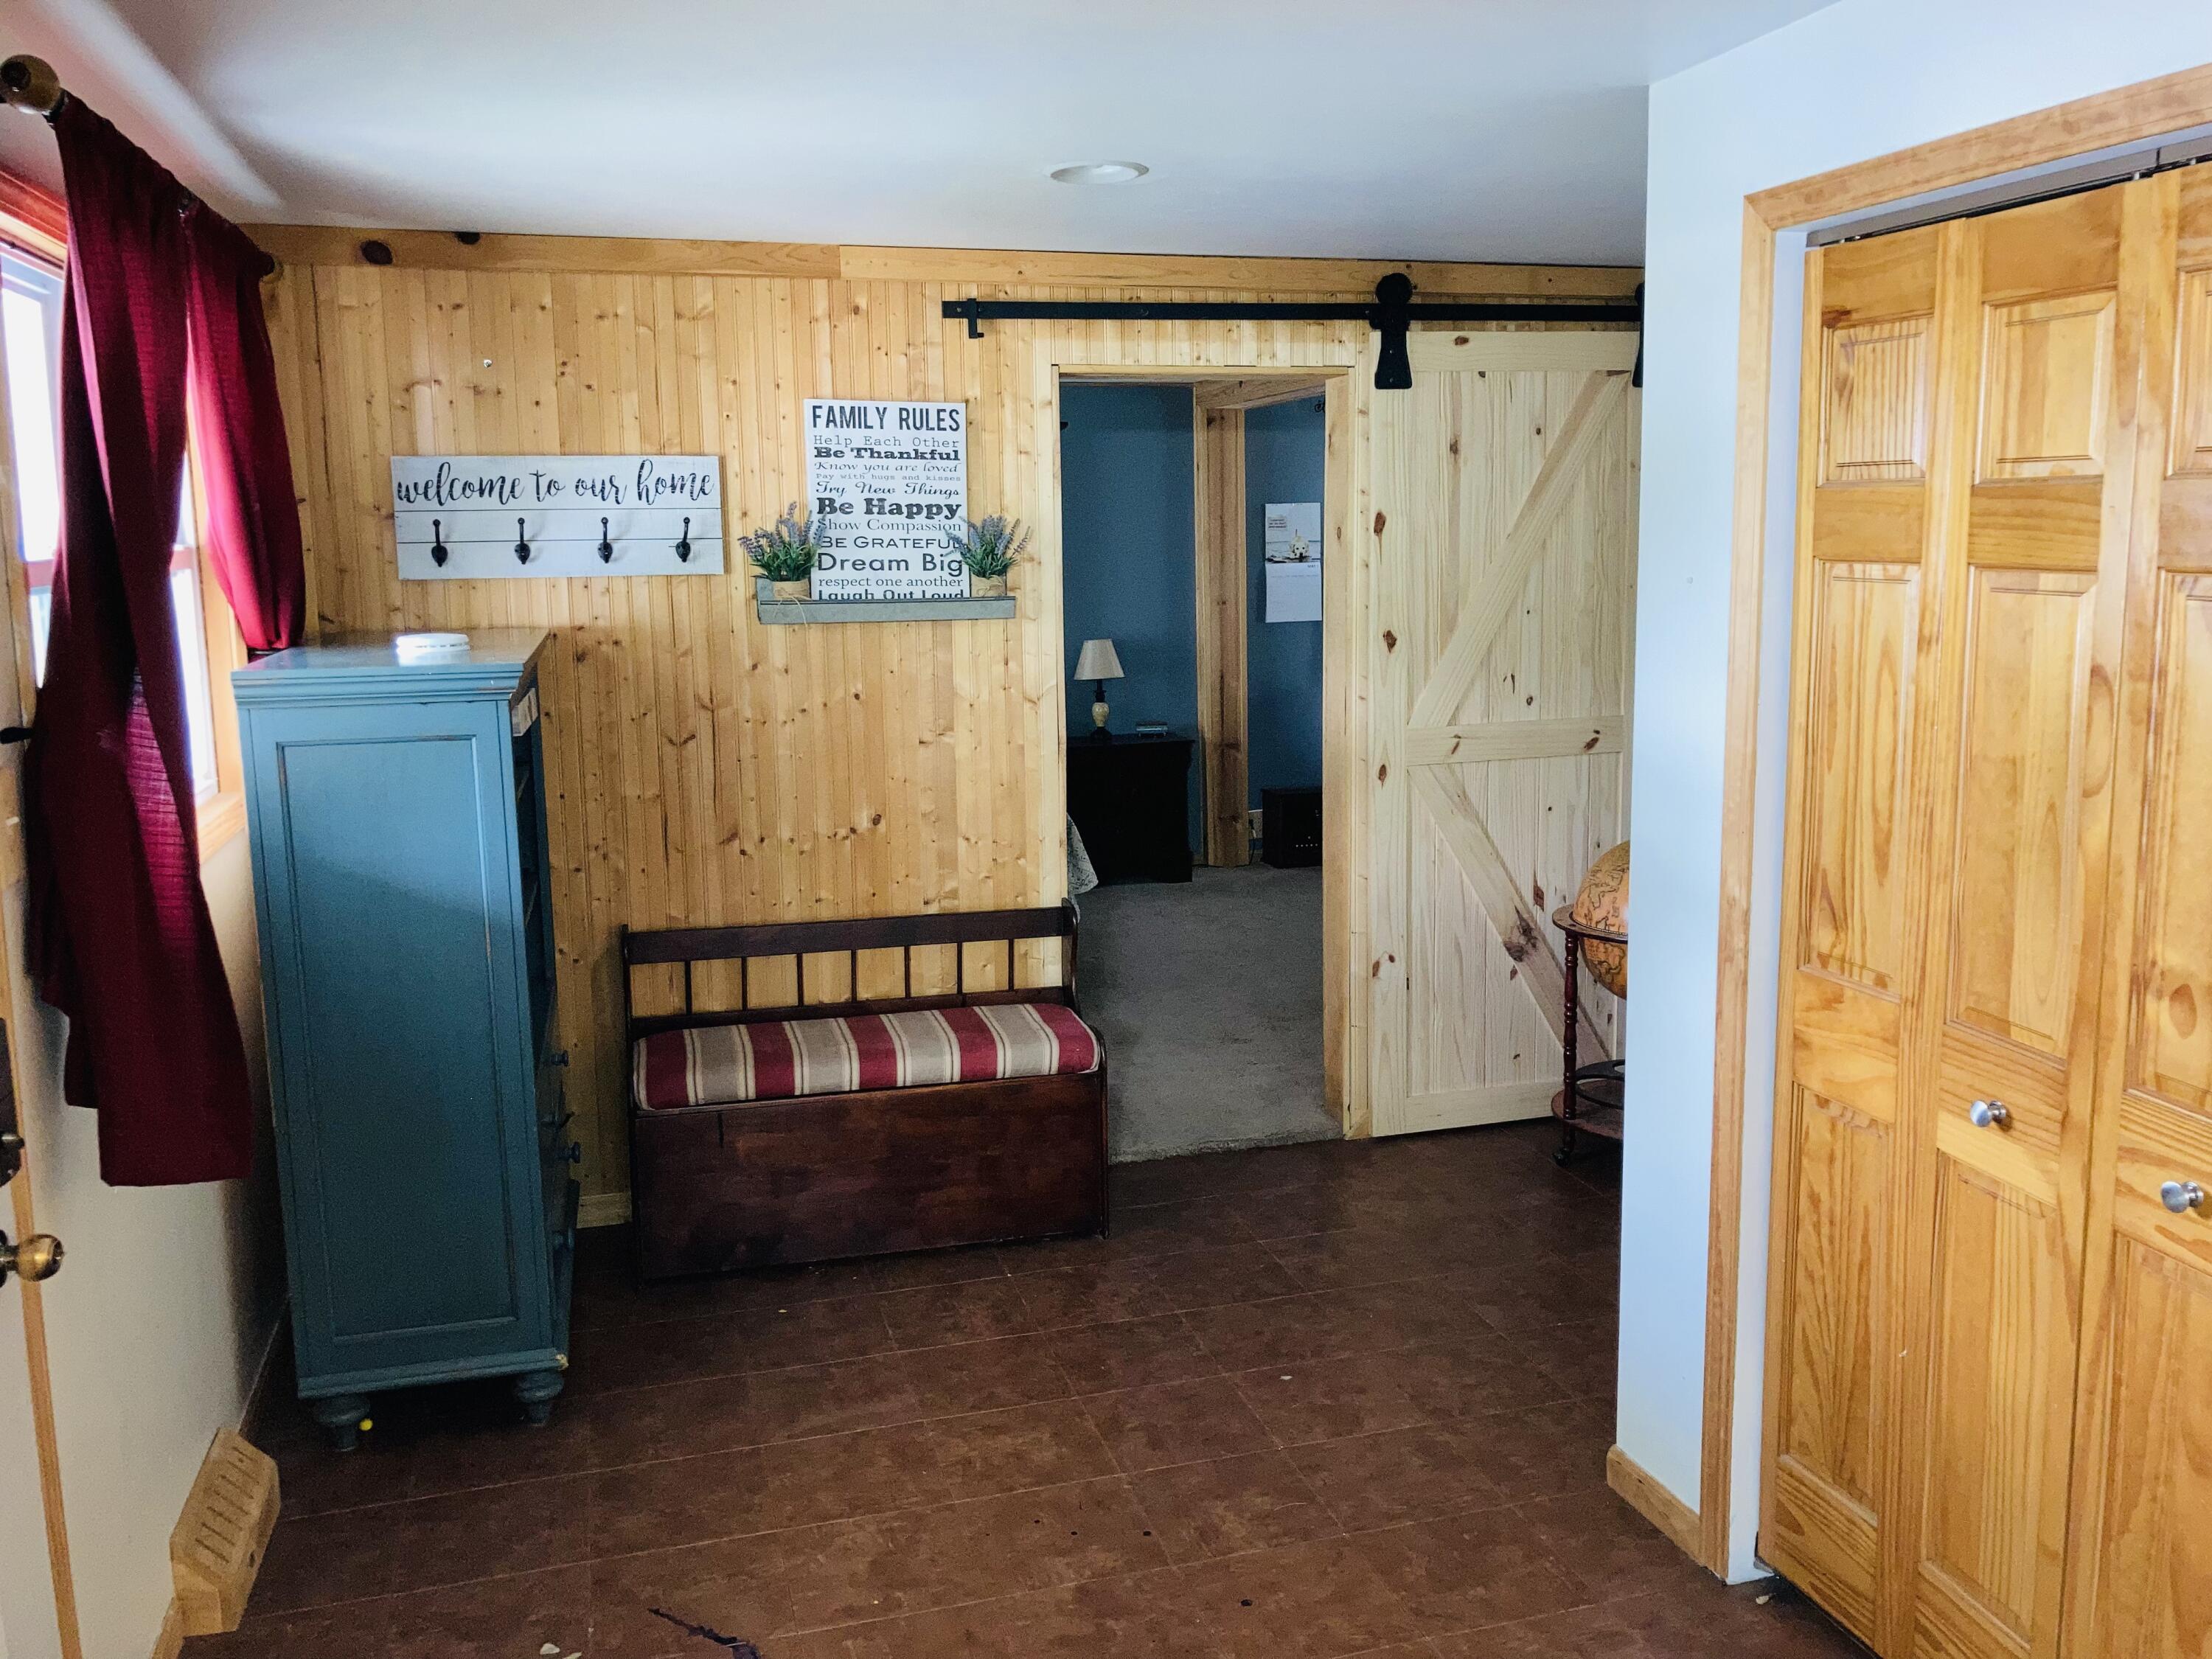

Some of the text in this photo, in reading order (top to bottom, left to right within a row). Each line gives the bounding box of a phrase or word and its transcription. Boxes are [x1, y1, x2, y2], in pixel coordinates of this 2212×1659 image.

[812, 405, 960, 432] FAMILY RULES
[814, 435, 959, 448] Help Each Other
[814, 446, 961, 461] Be Thankful
[814, 462, 858, 470] Know
[863, 465, 890, 474] you
[923, 462, 961, 473] loved
[398, 459, 714, 507] welcome to our home
[815, 481, 960, 500] Try New Things
[816, 498, 962, 521] Be Happy
[818, 518, 961, 533] Show Compassion
[821, 536, 847, 548] BE
[818, 552, 963, 577] Dream Big
[818, 576, 964, 589] respect one another
